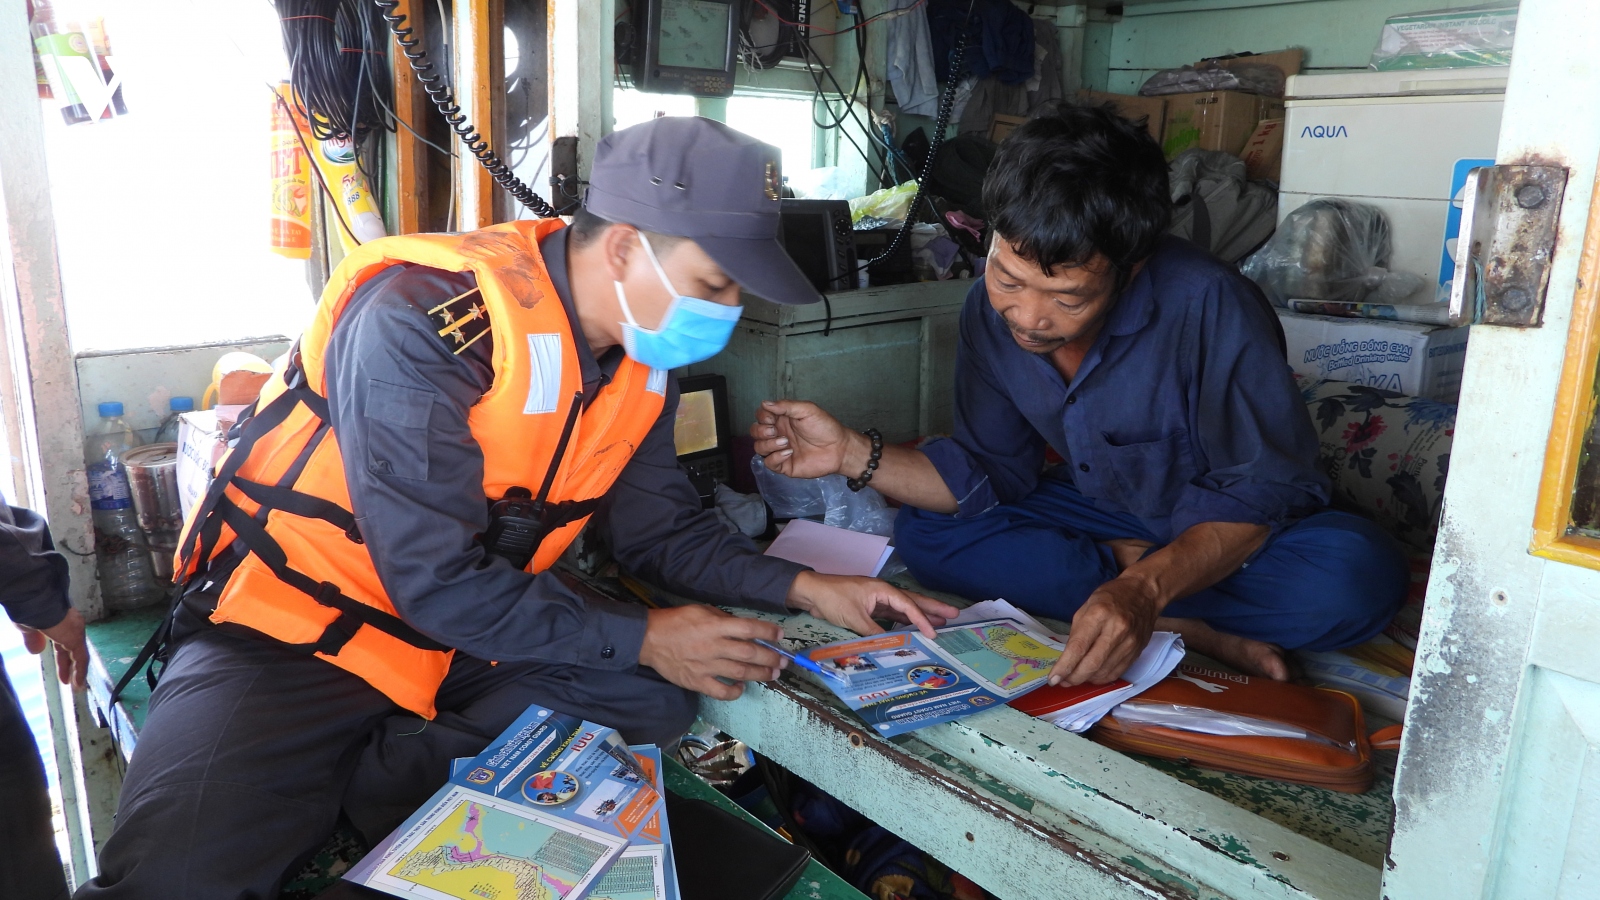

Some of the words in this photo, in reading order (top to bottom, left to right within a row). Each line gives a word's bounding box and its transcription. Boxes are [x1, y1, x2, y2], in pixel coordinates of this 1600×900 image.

[1439, 20, 1465, 28] INSTANT
[1301, 125, 1348, 139] AQUA
[1304, 344, 1331, 363] NƯỚC
[1332, 339, 1359, 354] UỐNG
[1361, 339, 1388, 352] ĐÓNG
[1390, 343, 1412, 356] CHAI
[1328, 356, 1352, 371] Bottled
[1354, 354, 1385, 365] Drinking
[1387, 354, 1411, 363] Water
[859, 690, 890, 702] IUU
[500, 760, 512, 769] VIET
[510, 750, 522, 761] NAM
[520, 738, 535, 752] COAST
[532, 725, 548, 739] GUARD
[570, 732, 595, 752] IUU
